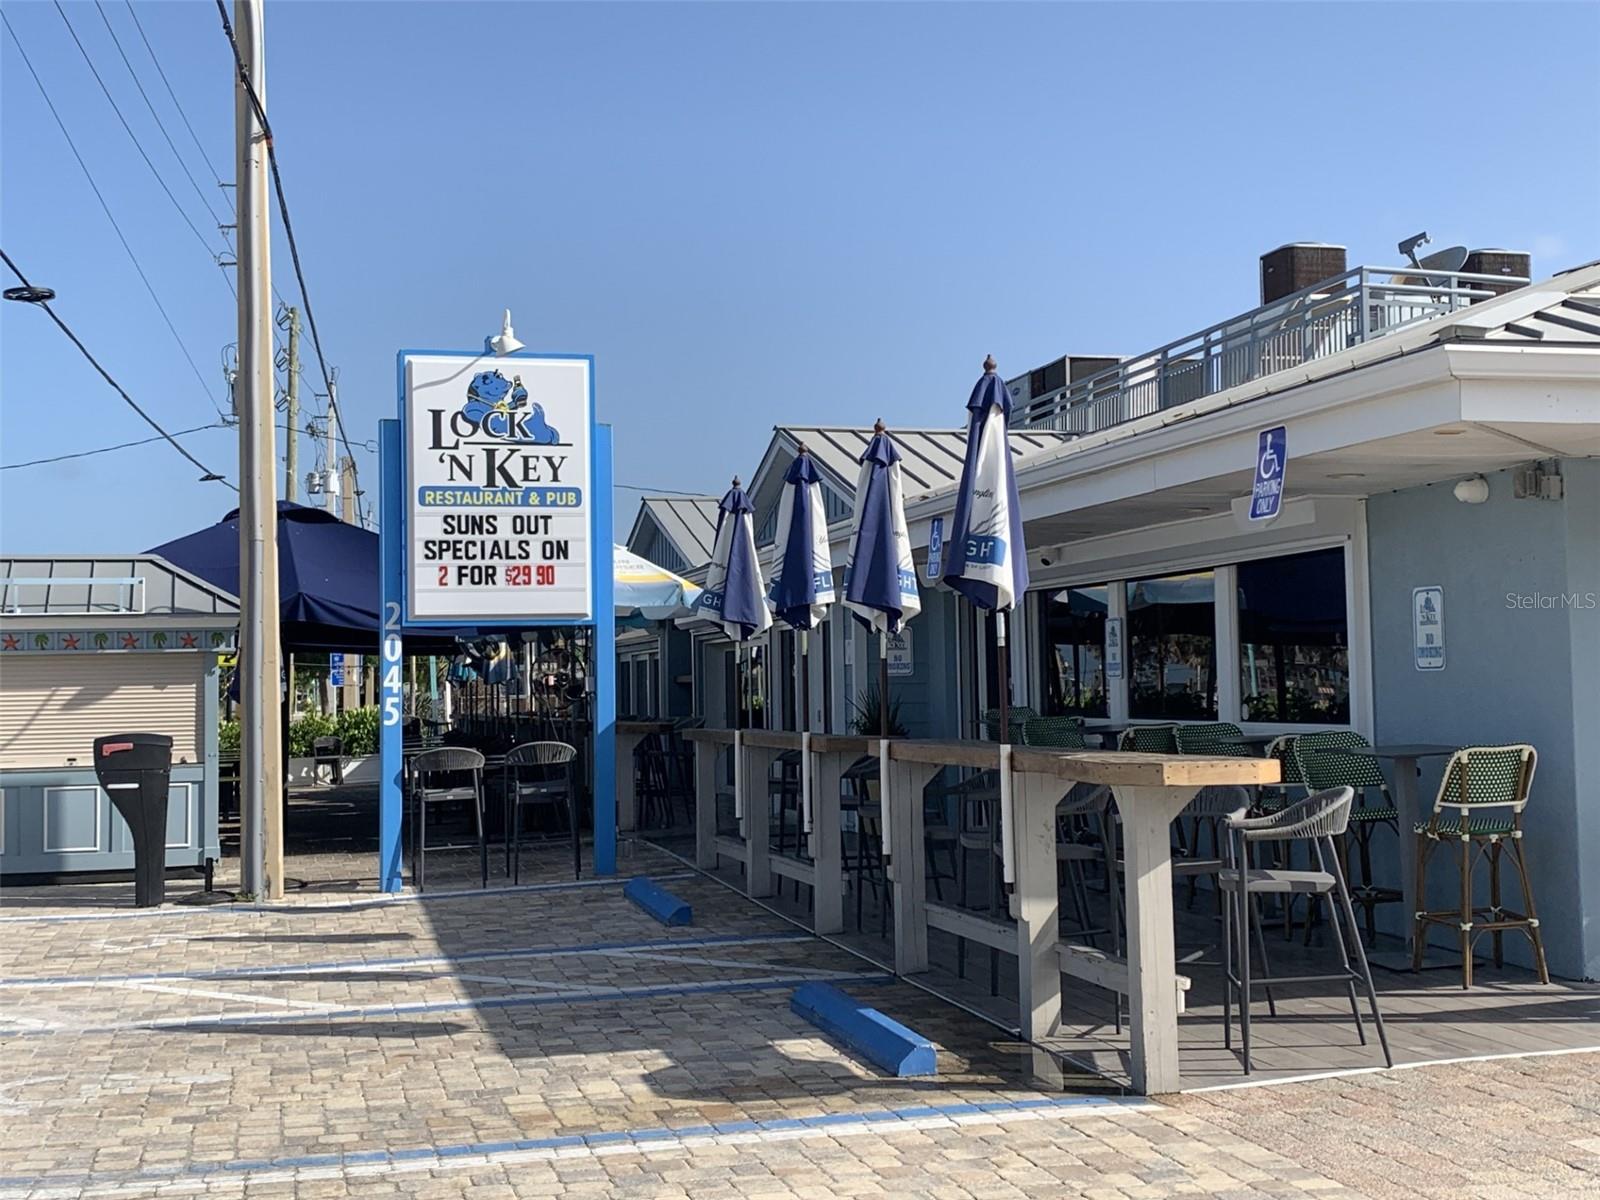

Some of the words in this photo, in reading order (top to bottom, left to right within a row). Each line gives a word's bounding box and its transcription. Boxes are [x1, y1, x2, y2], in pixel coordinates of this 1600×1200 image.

[425, 491, 524, 505] RESTAURANT
[529, 491, 540, 505] &
[546, 491, 576, 505] PUB
[443, 515, 497, 535] SUNS
[512, 515, 552, 535] OUT
[424, 540, 530, 560] SPECIALS
[542, 540, 569, 560] ON
[438, 566, 448, 586] 2
[457, 565, 497, 586] FOR
[383, 601, 402, 726] 2045
